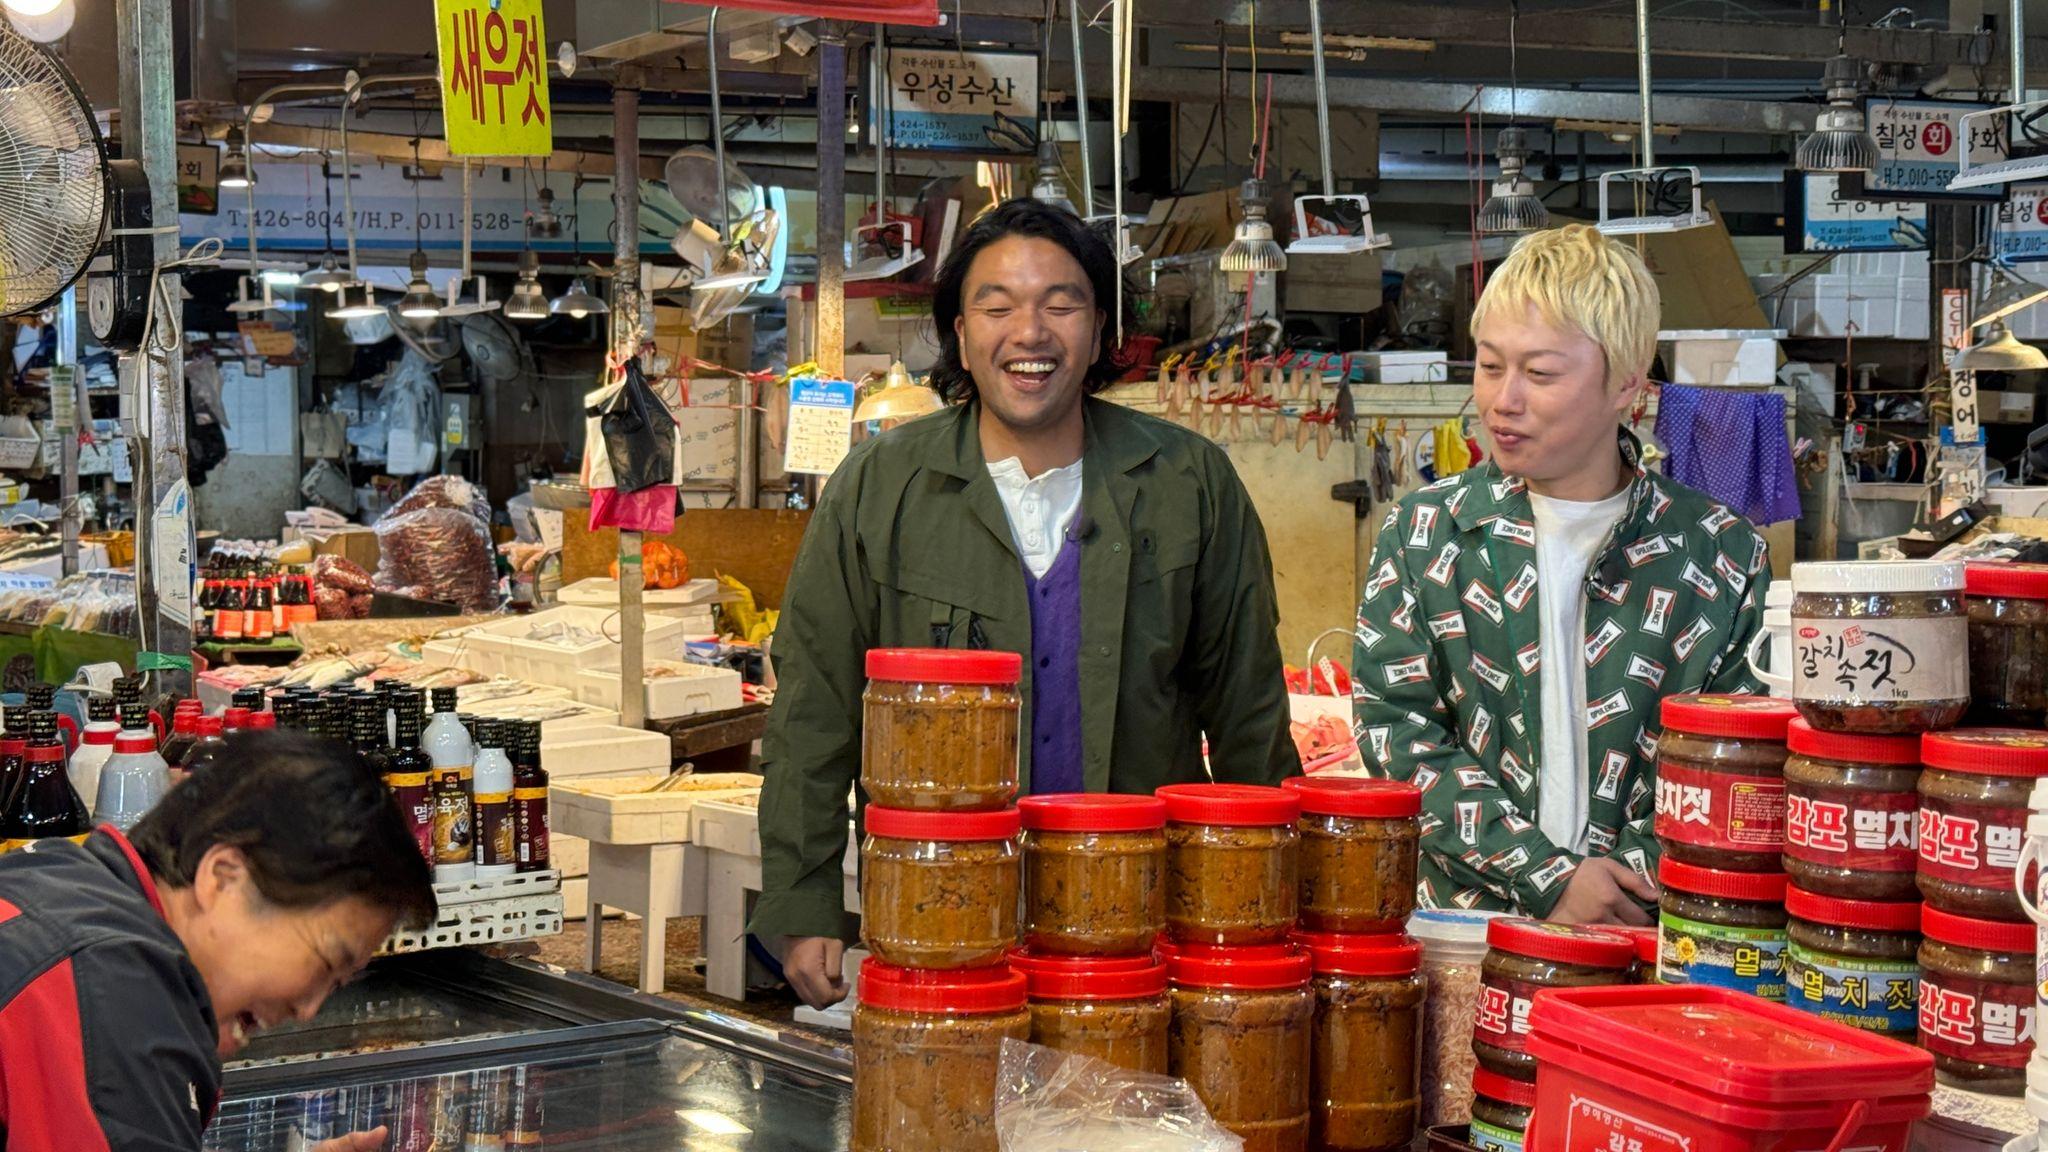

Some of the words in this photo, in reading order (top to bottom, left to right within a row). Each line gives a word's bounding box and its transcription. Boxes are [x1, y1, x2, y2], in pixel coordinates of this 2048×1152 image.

[451, 8, 546, 127] 새우젓
[898, 72, 1016, 106] 우성수산
[1875, 122, 1918, 151] 칠성
[1926, 125, 1946, 152] 회
[1954, 369, 1976, 425] 장어
[1501, 523, 1531, 538] OPULENCE
[1635, 541, 1661, 557] OPULENCE
[1511, 573, 1533, 600] OPULENCE
[1473, 591, 1500, 613] OPULENCE
[1651, 596, 1665, 626] OPULENCE
[1588, 632, 1613, 655] OPULENCE
[1891, 688, 1909, 698] 1kg
[1590, 699, 1620, 719] OPULENCE
[1604, 760, 1621, 792] OPULENCE
[1463, 808, 1474, 839] OPULENCE
[1788, 793, 1848, 853] 감포
[1919, 808, 1979, 870] 감포
[1919, 979, 1976, 1046] 감포
